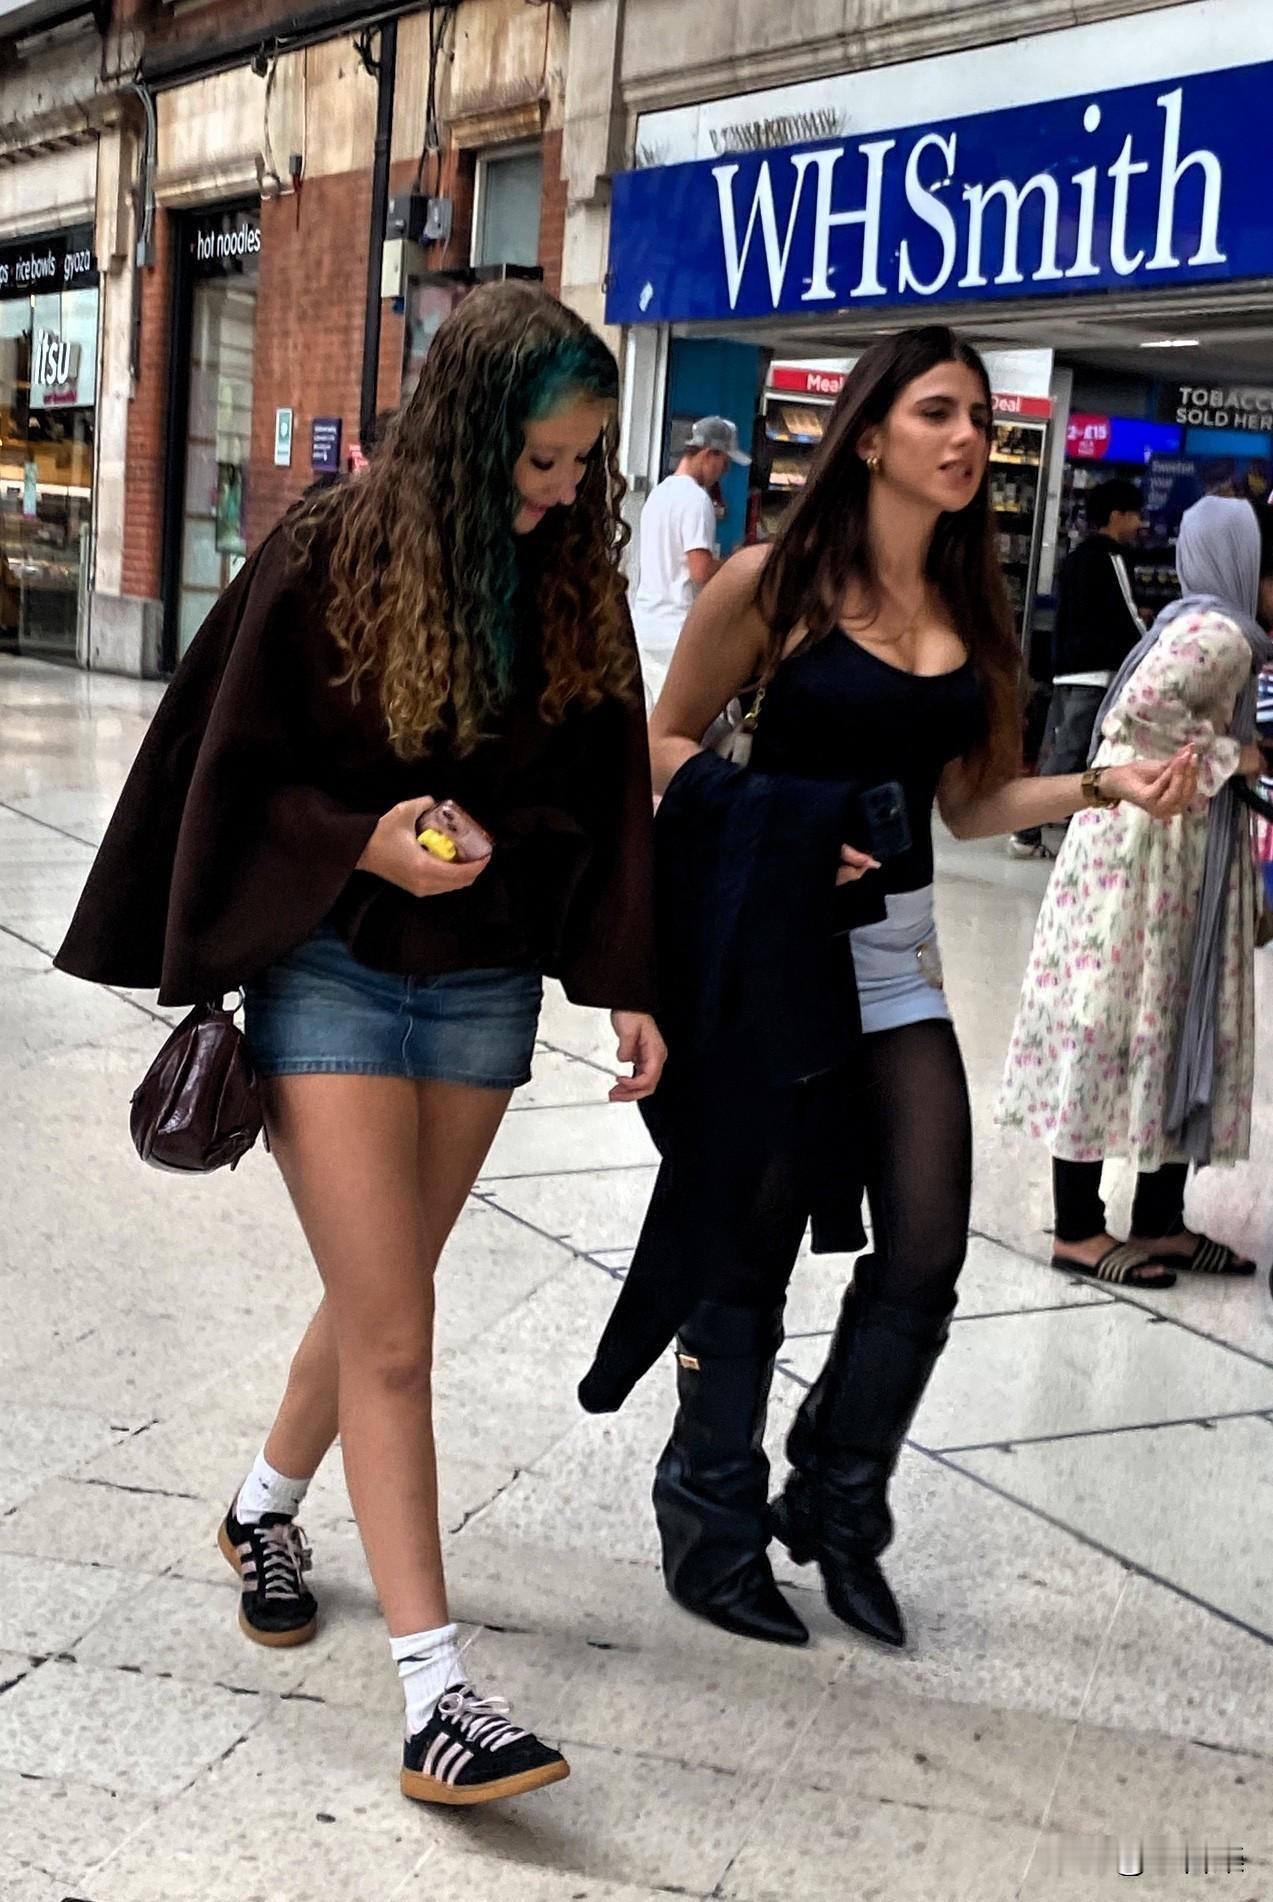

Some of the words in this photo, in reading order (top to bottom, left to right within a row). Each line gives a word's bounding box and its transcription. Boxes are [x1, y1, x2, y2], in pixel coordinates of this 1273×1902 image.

[712, 88, 1227, 309] WHSmith
[197, 230, 215, 260] hot
[217, 224, 261, 256] noodles
[16, 256, 30, 281] rice
[31, 249, 55, 279] bowls
[64, 248, 90, 281] gyoza
[35, 329, 70, 384] itsu
[1179, 387, 1273, 411] TOBACC
[1176, 407, 1229, 427] SOLD
